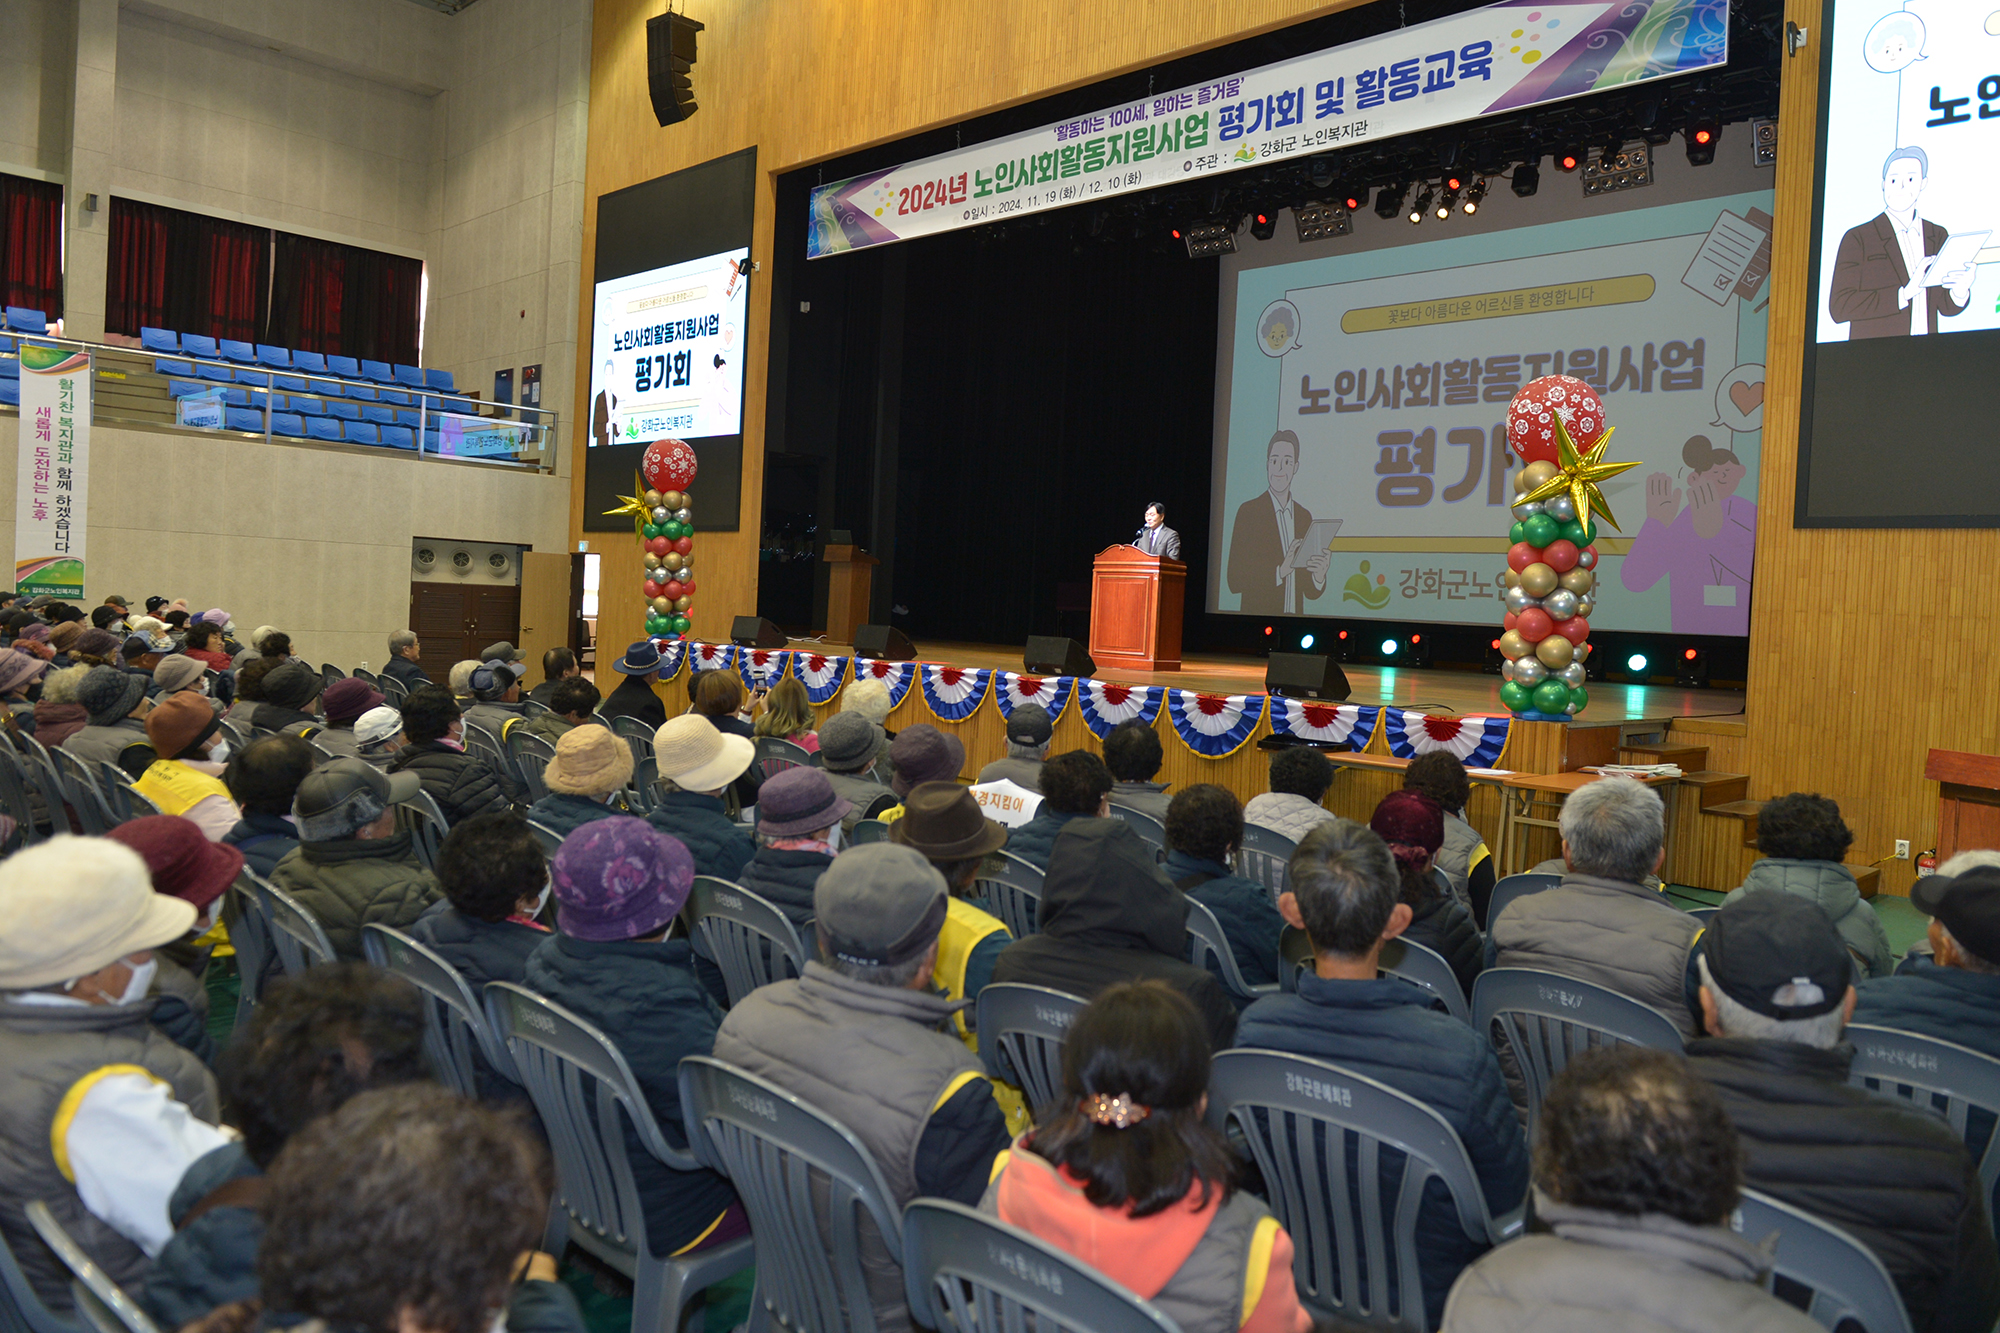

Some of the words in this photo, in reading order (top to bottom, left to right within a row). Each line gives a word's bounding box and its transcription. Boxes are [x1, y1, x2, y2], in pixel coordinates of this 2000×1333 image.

[897, 171, 968, 216] 2024년
[973, 110, 1209, 199] 노인사회활동지원사업
[1217, 86, 1304, 142] 평가회
[1314, 76, 1345, 120] 및
[1355, 39, 1494, 110] 활동교육
[1109, 102, 1149, 128] 100세,
[1153, 93, 1193, 117] 일하는
[1194, 152, 1219, 172] 주관
[1260, 135, 1297, 158] 강화군
[1302, 119, 1369, 147] 노인복지관
[998, 198, 1023, 214] 2024.
[1027, 194, 1041, 207] 11.
[1045, 191, 1056, 203] 19
[1059, 184, 1077, 202] (화)
[1089, 180, 1103, 195] 12.
[1107, 175, 1120, 190] 10
[1123, 169, 1143, 188] (화)
[1388, 306, 1422, 325] 꽃보다
[1424, 300, 1472, 320] 아름다운
[1475, 293, 1525, 315] 어르신들
[1528, 285, 1595, 309] 환영합니다
[613, 312, 720, 352] 노인사회활동지원사업
[635, 348, 692, 393] 평가회
[1297, 337, 1707, 416] 노인사회활동지원사업
[58, 378, 75, 414] 활기찬
[35, 406, 52, 442] 새롭게
[57, 416, 75, 464] 복지관과
[640, 413, 694, 434] 강화군노인복지관
[32, 446, 51, 494] 도전하는
[56, 466, 73, 492] 함께
[1373, 421, 1516, 508] 평가
[31, 497, 49, 521] 노후
[54, 494, 72, 554] 하겠습니다
